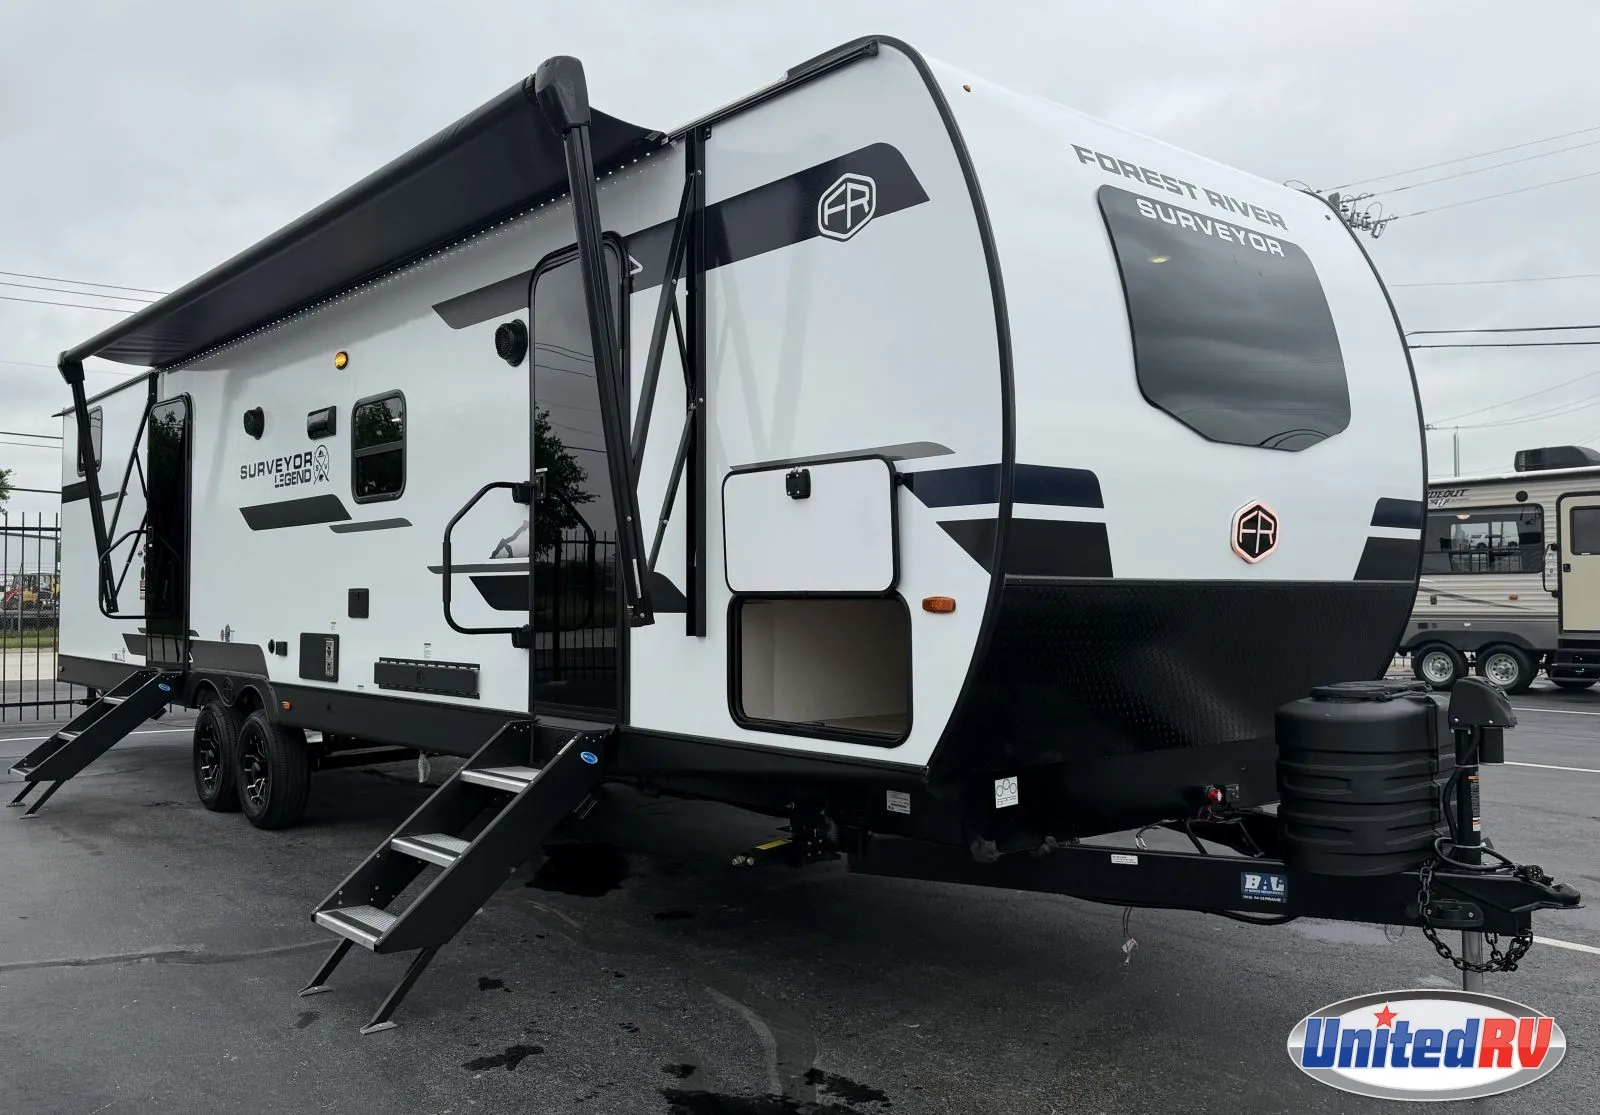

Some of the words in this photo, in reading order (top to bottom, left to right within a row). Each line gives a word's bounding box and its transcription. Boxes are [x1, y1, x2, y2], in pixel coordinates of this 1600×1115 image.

[1070, 143, 1198, 200] FOREST
[1202, 187, 1288, 231] RIVER
[1136, 198, 1285, 257] SURVEYOR
[240, 451, 313, 480] SURVEYOR
[274, 468, 312, 489] LEGEND
